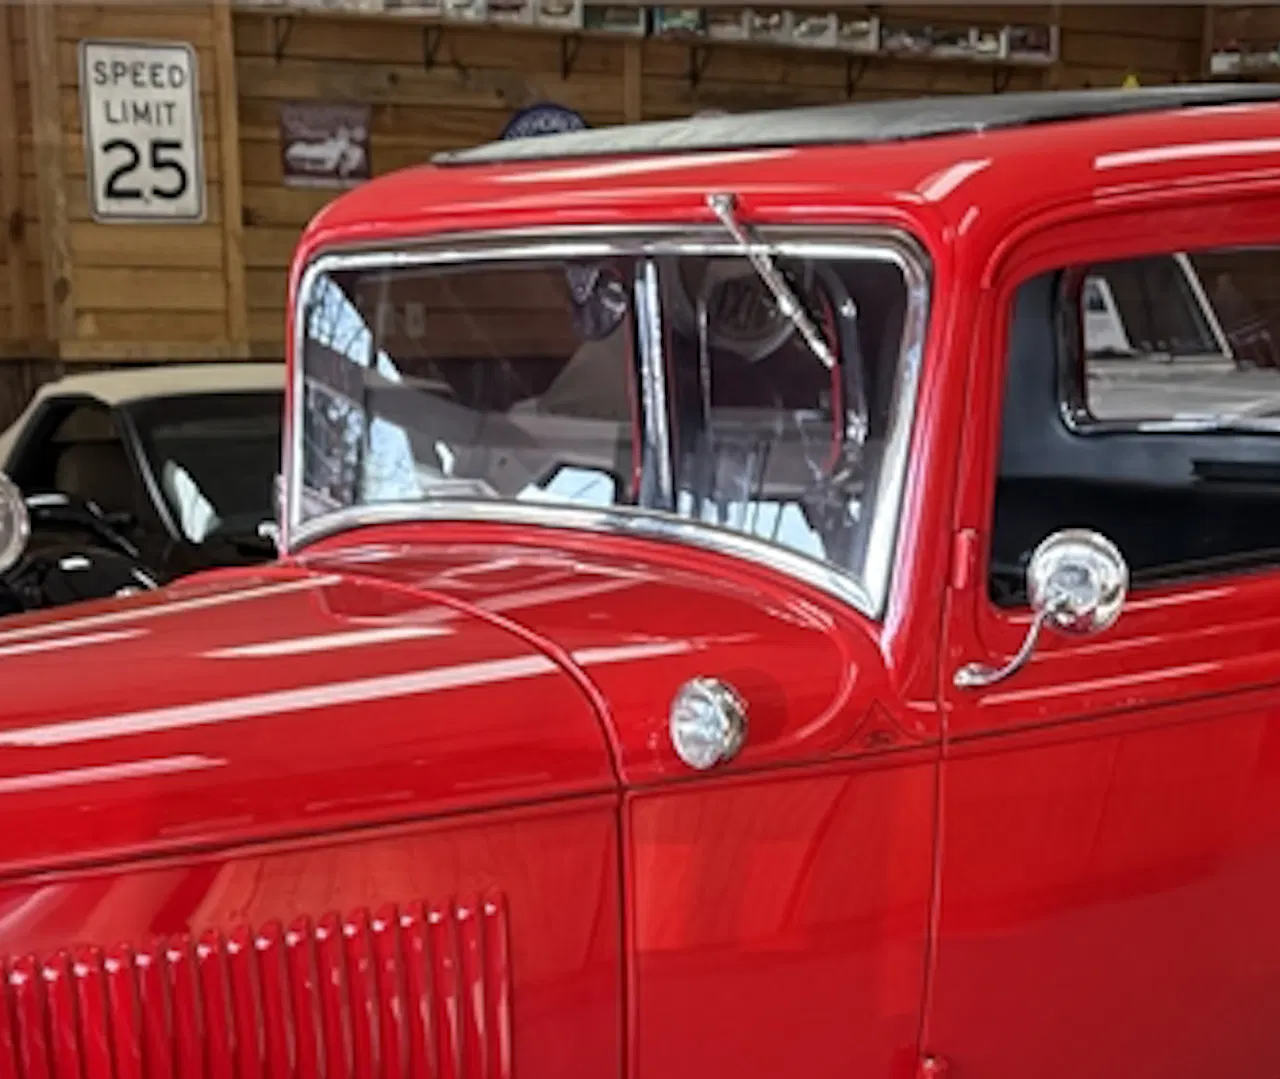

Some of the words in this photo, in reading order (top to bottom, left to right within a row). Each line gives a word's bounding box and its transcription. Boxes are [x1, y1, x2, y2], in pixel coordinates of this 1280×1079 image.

[93, 60, 185, 89] SPEED
[104, 100, 177, 126] LIMIT
[102, 139, 187, 199] 25
